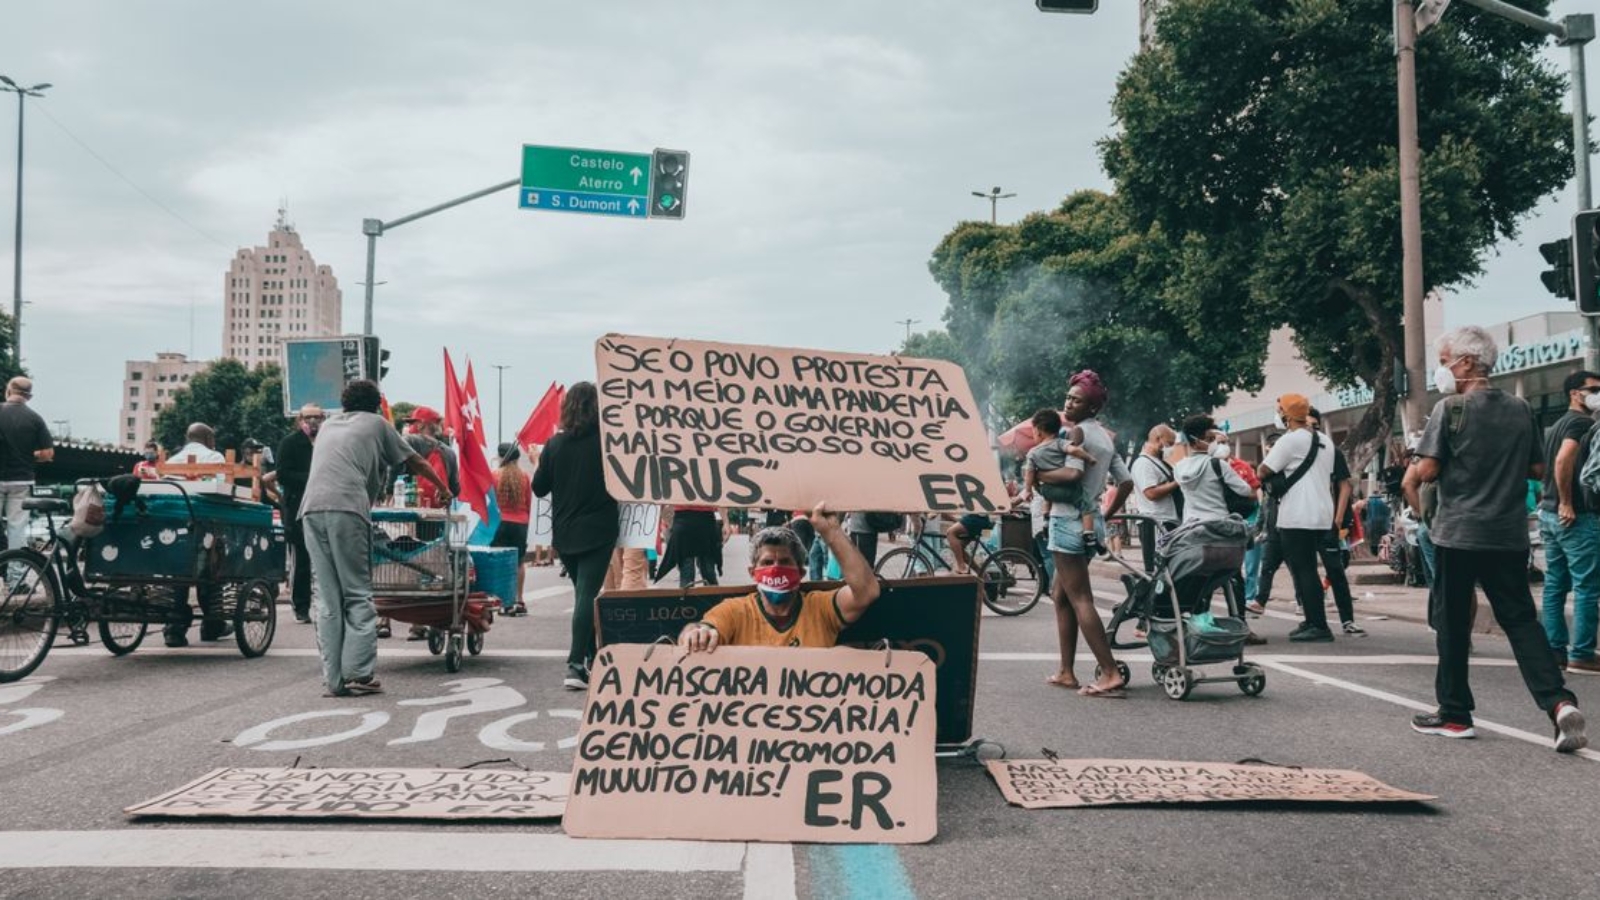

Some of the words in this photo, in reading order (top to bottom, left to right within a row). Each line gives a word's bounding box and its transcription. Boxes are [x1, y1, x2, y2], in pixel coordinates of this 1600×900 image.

[570, 154, 624, 171] Castelo
[579, 176, 623, 190] Aterro
[551, 195, 565, 207] S.
[569, 196, 621, 211] Dumont
[705, 349, 779, 379] POVO
[791, 355, 948, 392] PROTESTA
[602, 378, 654, 400] EM
[664, 378, 745, 404] MEIO
[752, 387, 774, 406] A
[776, 385, 829, 411] UMA
[831, 388, 970, 420] PANDEMIA
[602, 400, 630, 427] É
[635, 404, 743, 432] PORQUE
[755, 411, 777, 432] O
[785, 413, 915, 440] GOVERNO
[920, 419, 946, 440] É
[605, 429, 682, 456] MAIS
[692, 430, 864, 456] PERIGOSO
[871, 440, 934, 463] QUE
[944, 444, 969, 463] O
[918, 474, 1006, 512] E.R.
[762, 575, 789, 587] FORA
[597, 651, 622, 696] "A
[633, 652, 768, 697] MÁSCARA
[778, 667, 926, 701] INCOMODA
[587, 698, 660, 729] MAS
[668, 698, 701, 728] É
[697, 699, 919, 736] NECESSÁRIA!
[580, 729, 738, 762] GENOCIDA
[748, 740, 897, 764] INCOMODA
[220, 772, 406, 782] QUANDO
[432, 772, 550, 784] TUDO
[312, 782, 535, 794] PRIVADO
[575, 762, 697, 796] MUUUITO
[702, 764, 791, 798] MAIS!
[249, 801, 411, 812] TUDO
[803, 769, 906, 831] E.R.
